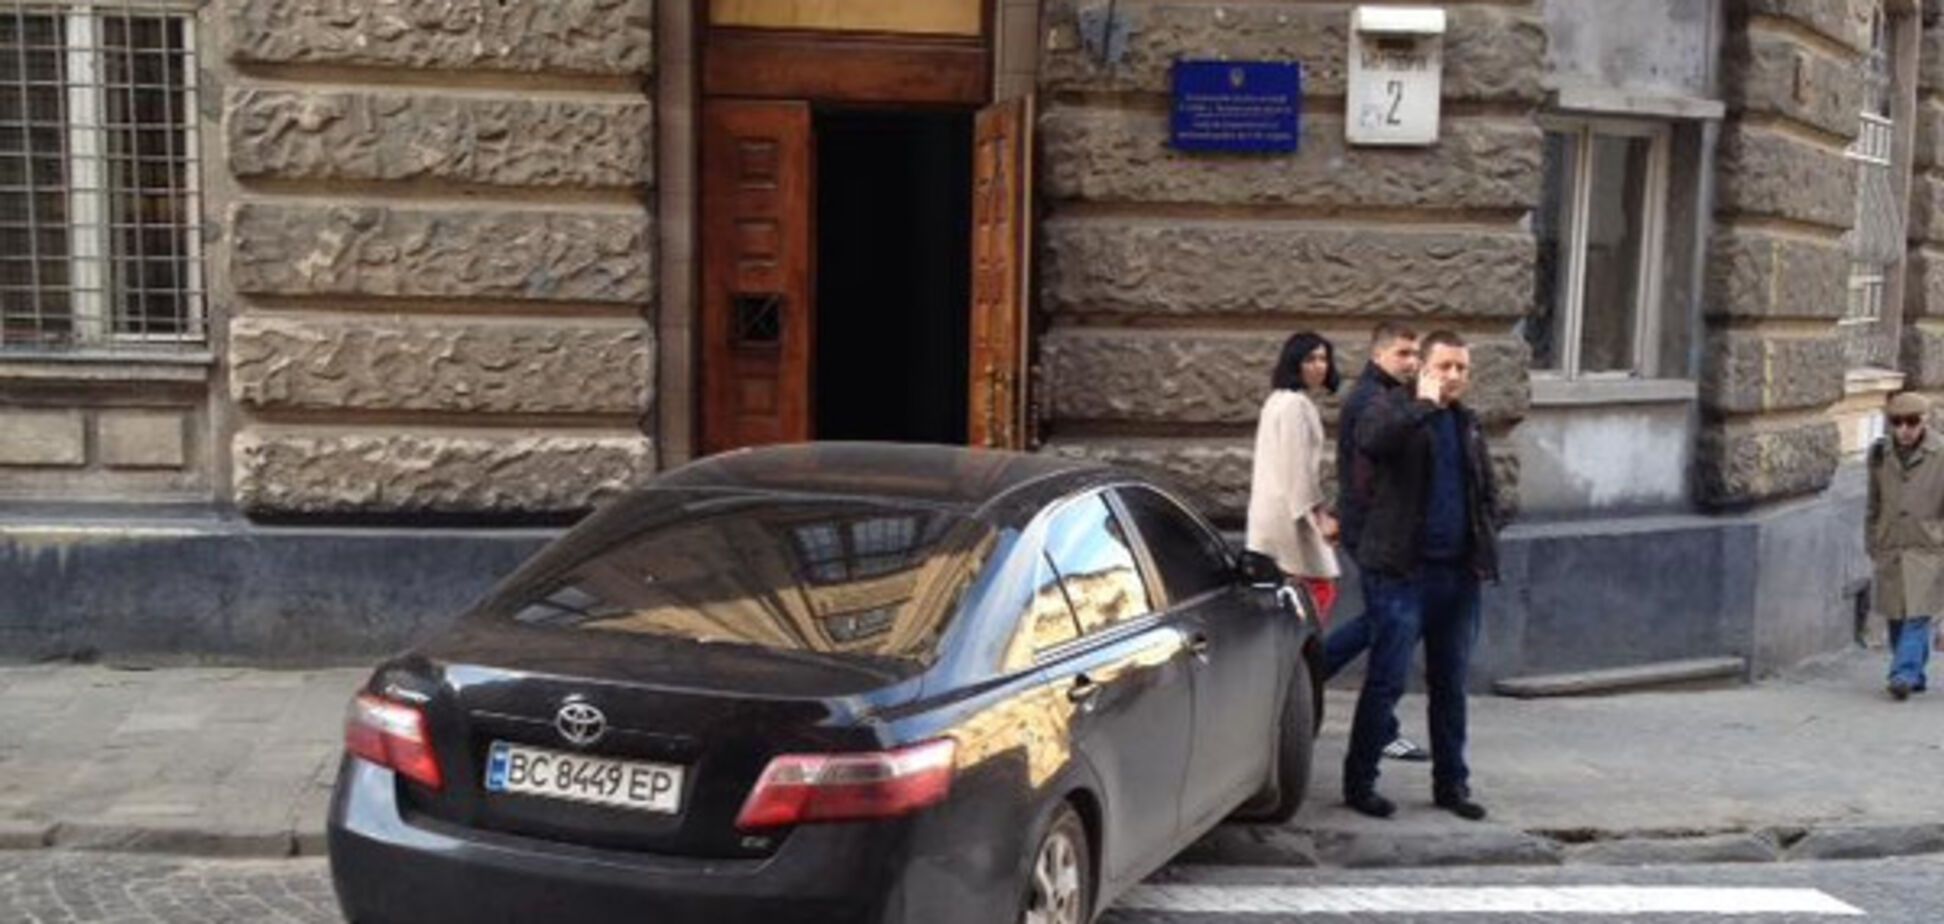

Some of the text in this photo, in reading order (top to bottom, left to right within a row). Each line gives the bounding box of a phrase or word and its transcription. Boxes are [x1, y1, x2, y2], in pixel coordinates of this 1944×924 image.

[1386, 80, 1402, 126] 2
[509, 753, 672, 801] BC 8449 EP
